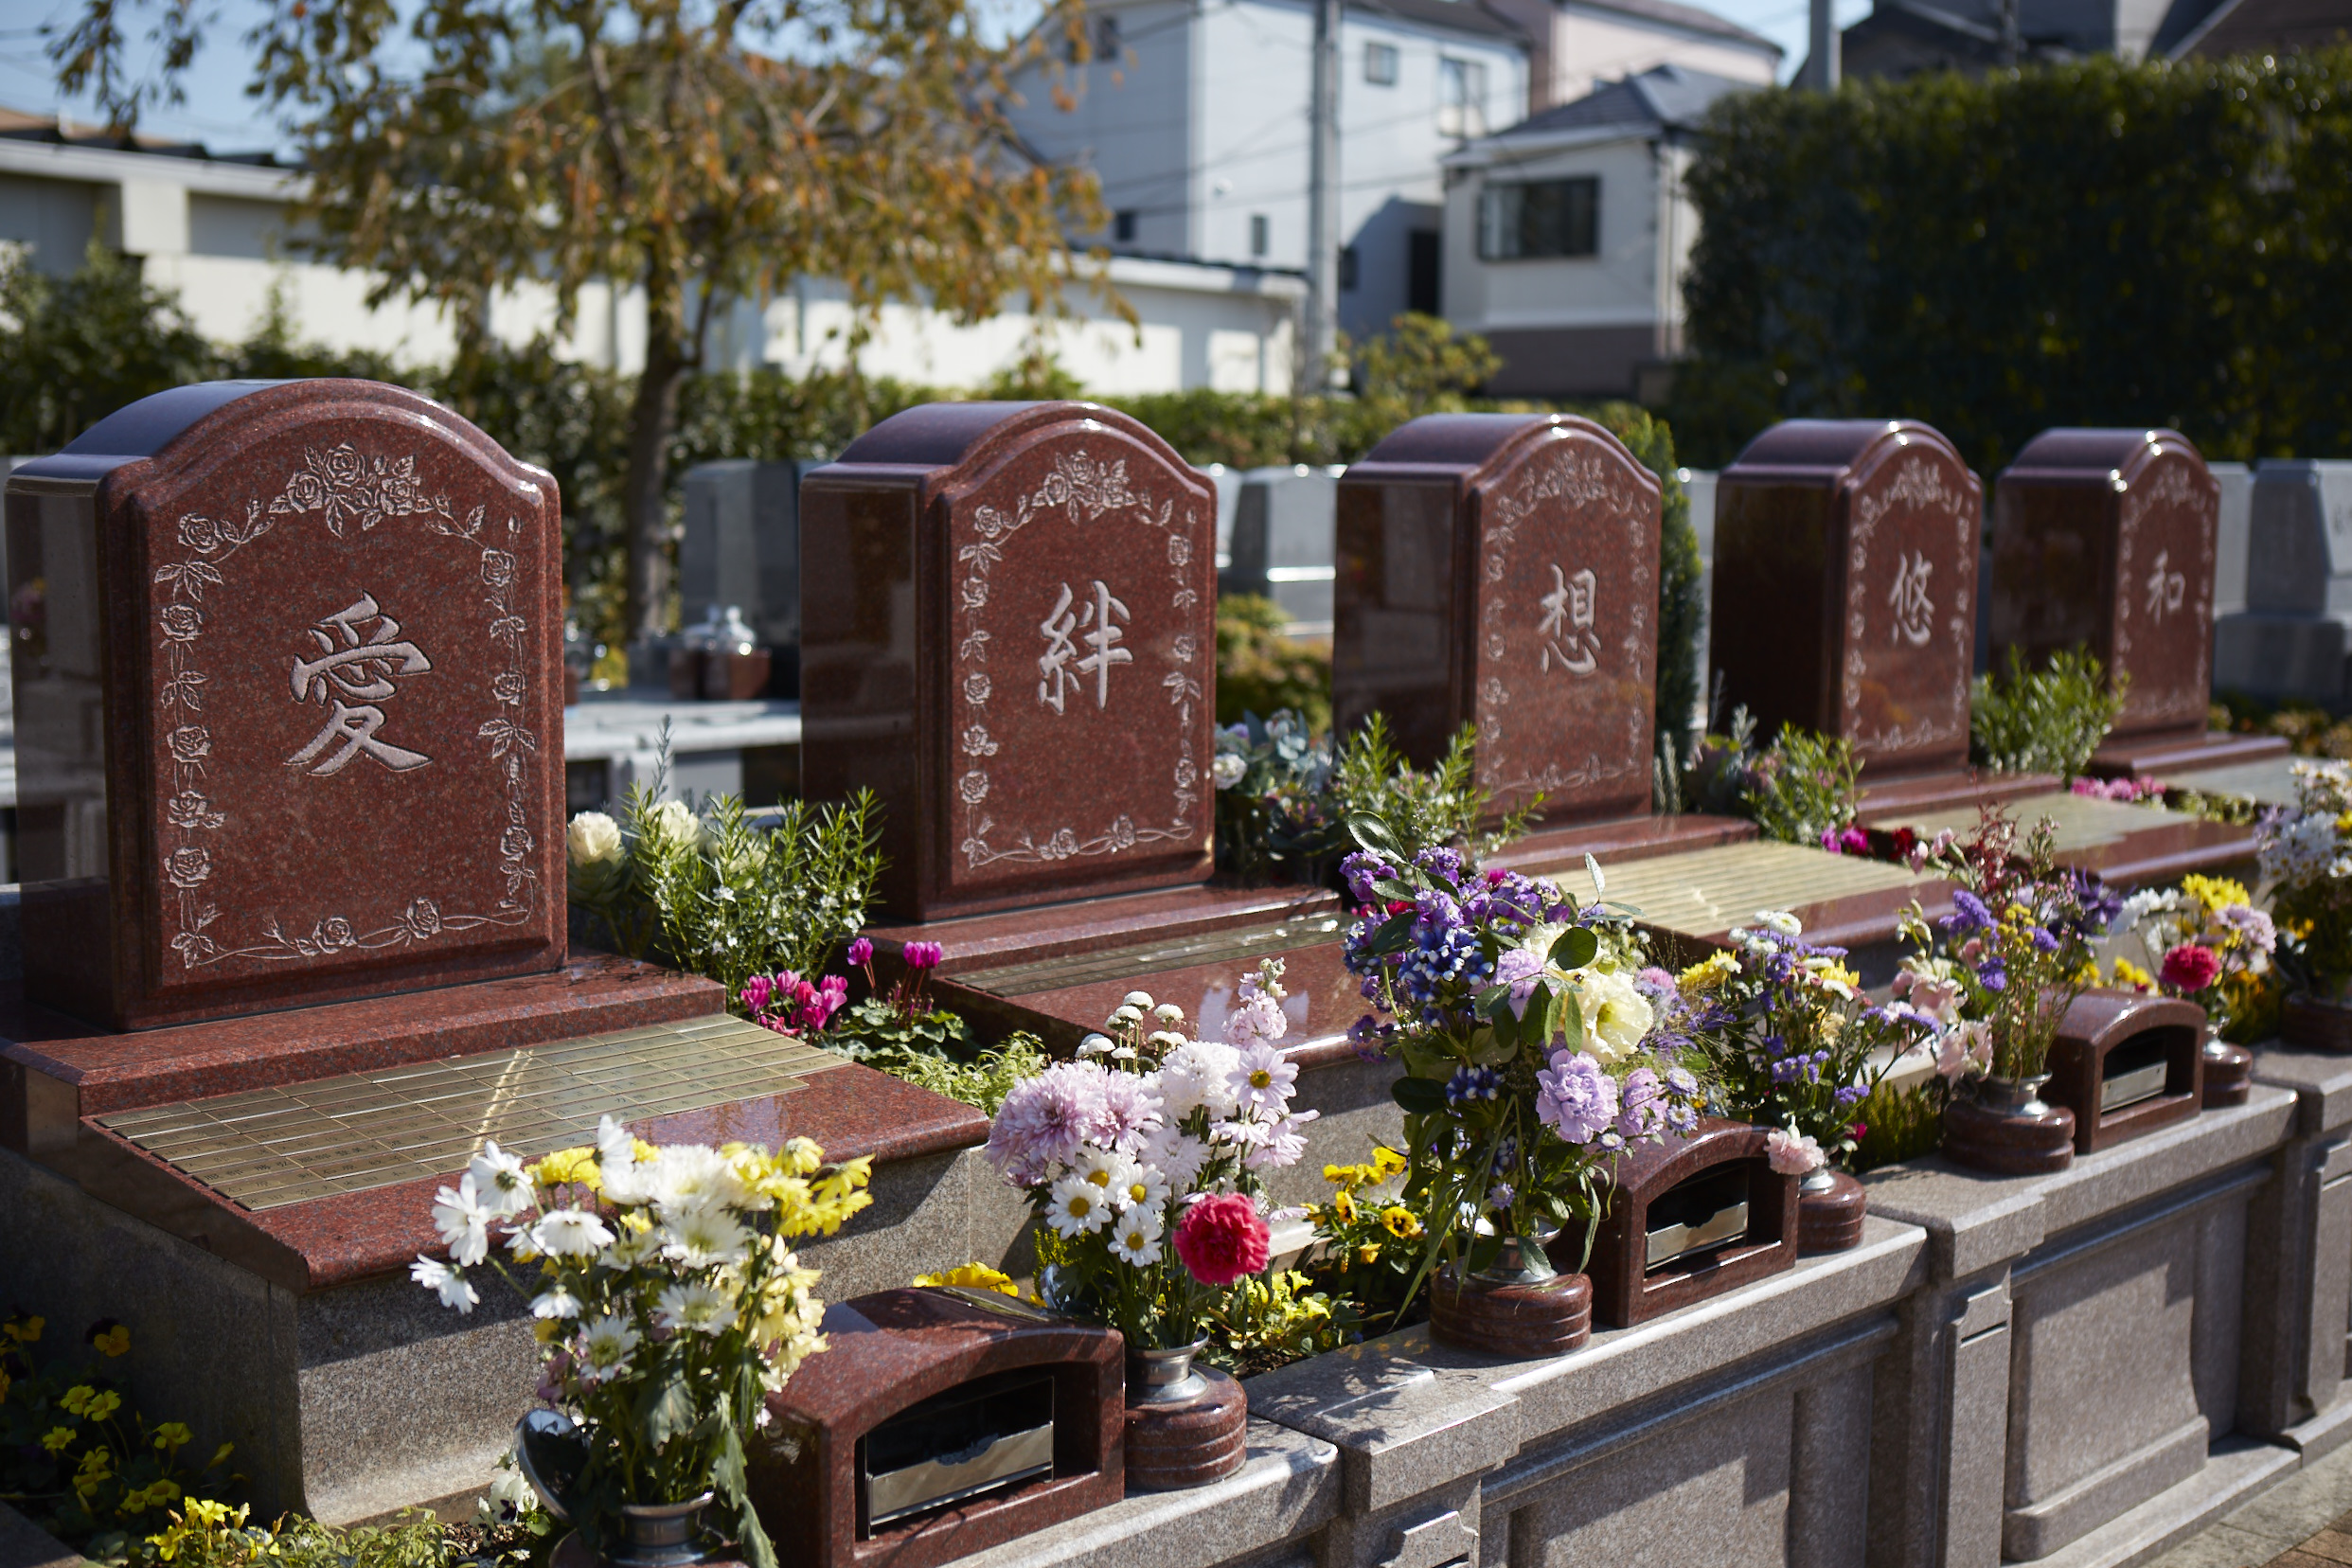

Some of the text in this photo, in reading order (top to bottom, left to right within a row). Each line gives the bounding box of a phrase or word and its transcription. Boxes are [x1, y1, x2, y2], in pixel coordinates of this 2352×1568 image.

[1538, 562, 1601, 676] 想
[1888, 548, 1935, 648] 悠
[2145, 547, 2186, 626] 和
[283, 589, 434, 775] 愛
[1039, 579, 1133, 716] 絆
